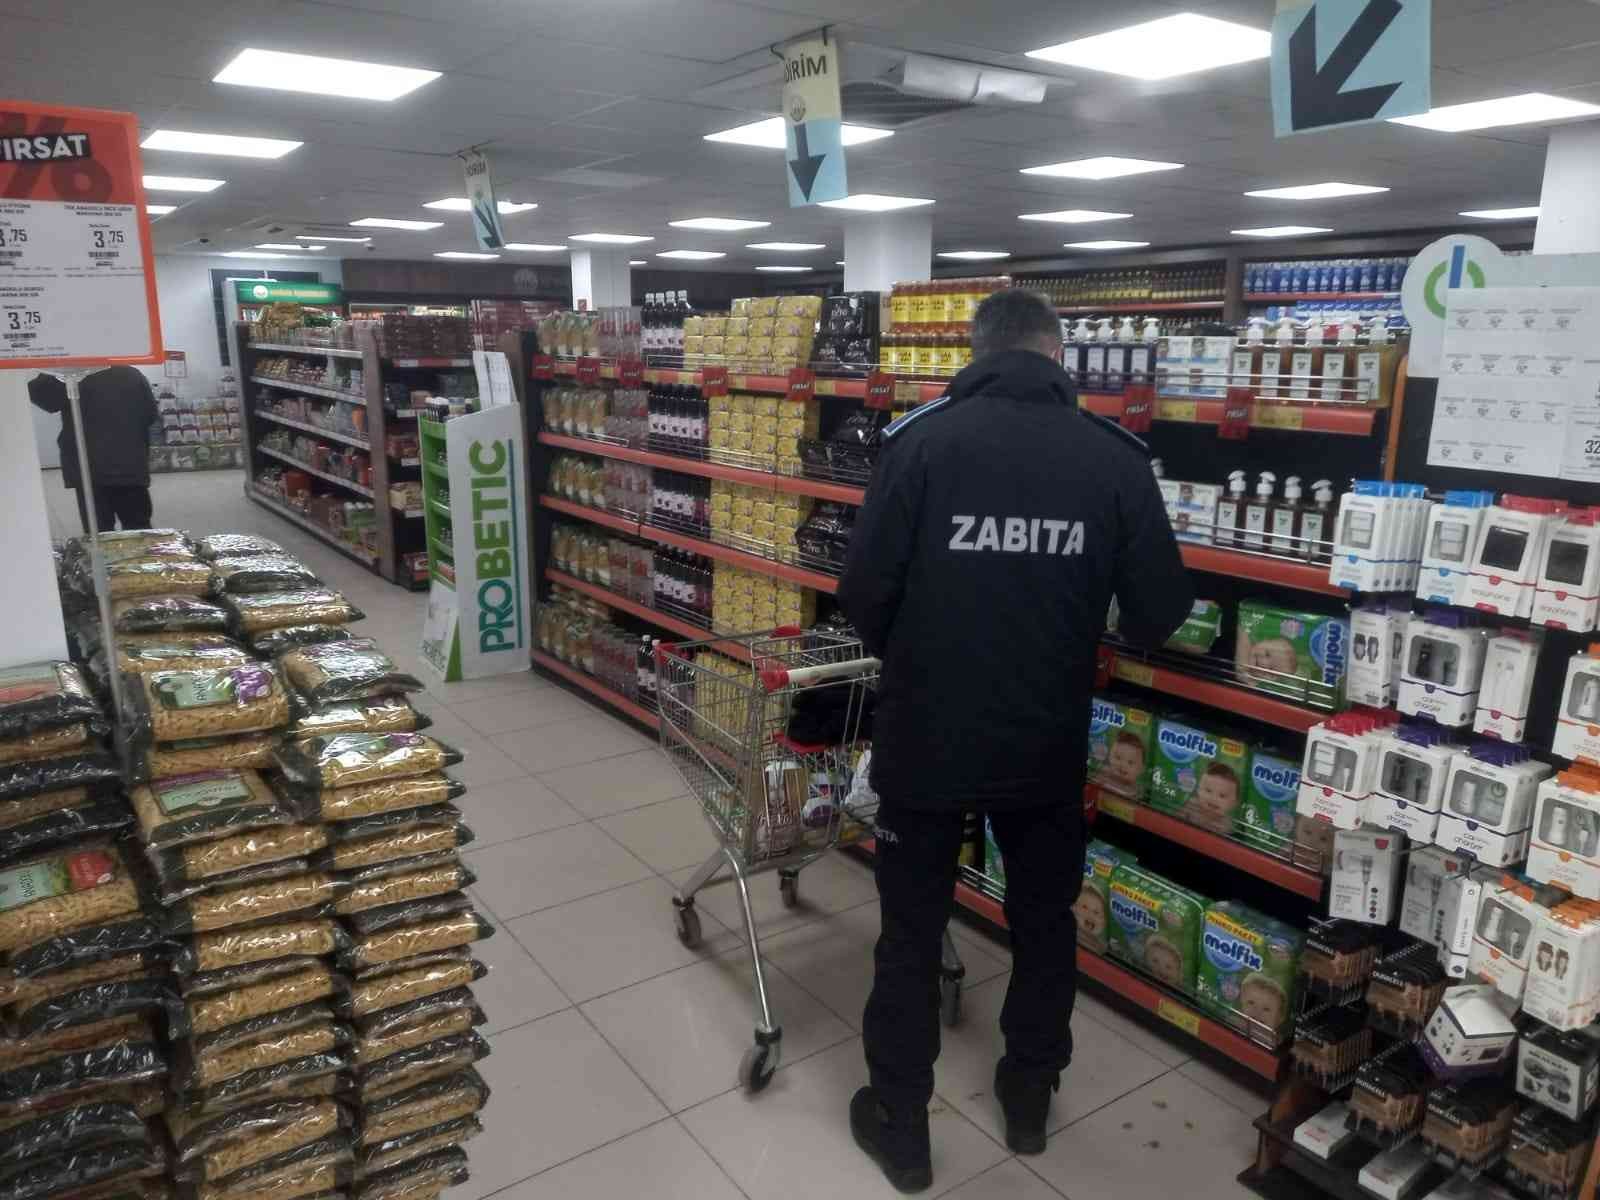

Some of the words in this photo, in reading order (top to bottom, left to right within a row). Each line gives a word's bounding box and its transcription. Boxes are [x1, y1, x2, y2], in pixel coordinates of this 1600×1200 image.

[0, 134, 87, 161] IRSAT
[469, 439, 516, 653] PROBETIC
[949, 515, 1085, 556] ZABITA
